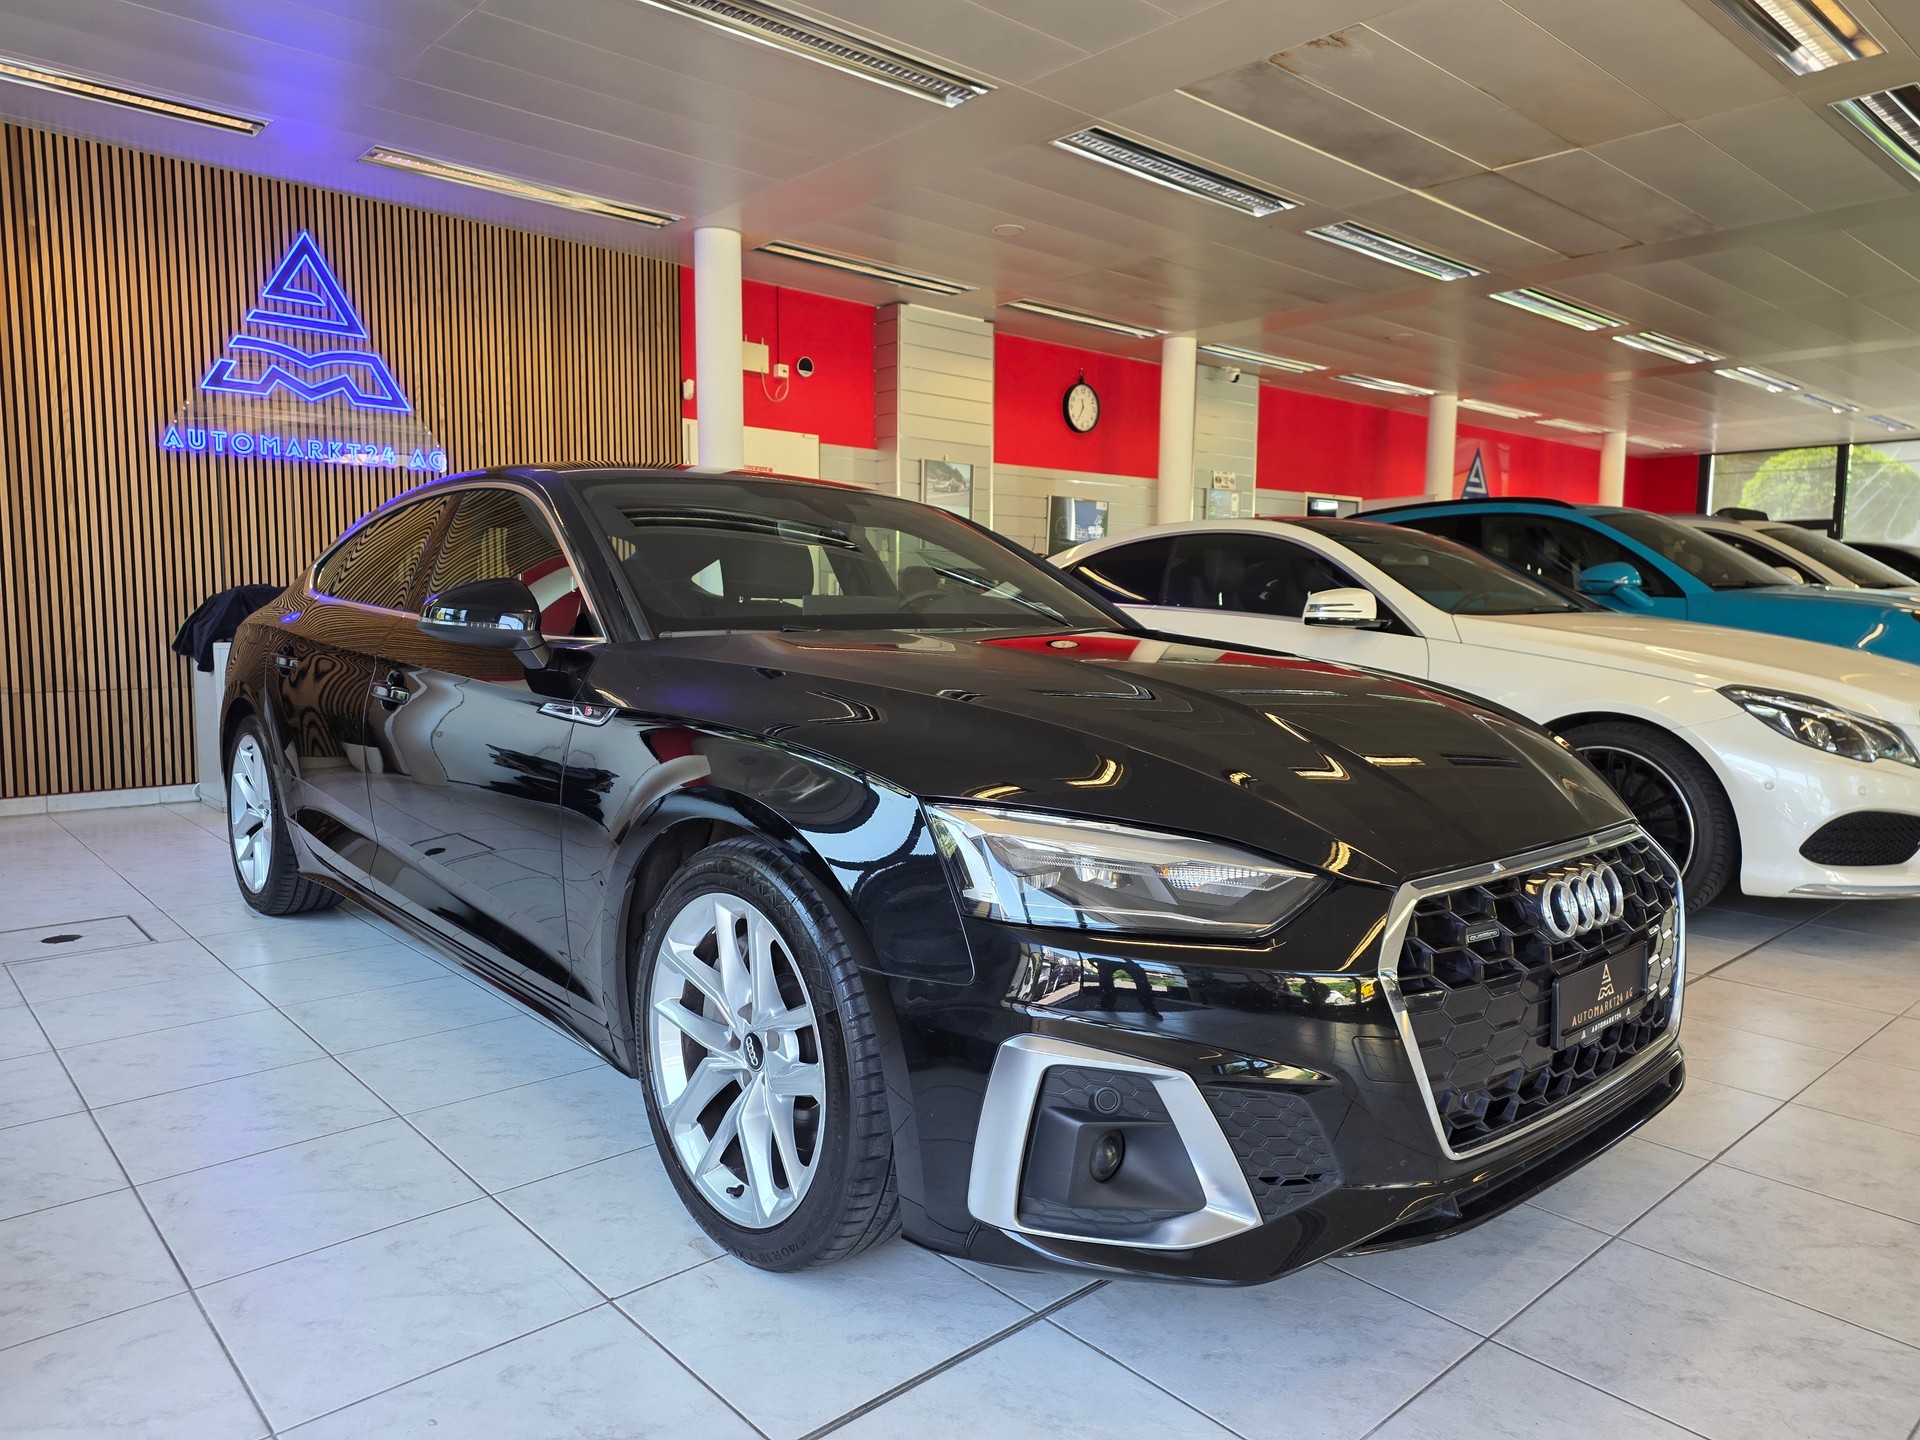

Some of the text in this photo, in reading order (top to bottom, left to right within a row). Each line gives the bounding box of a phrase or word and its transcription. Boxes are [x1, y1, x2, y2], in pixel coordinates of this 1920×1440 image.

[163, 426, 444, 469] AUTOMARKT24 AG
[1572, 987, 1633, 1026] AUTOMARKT24 AG
